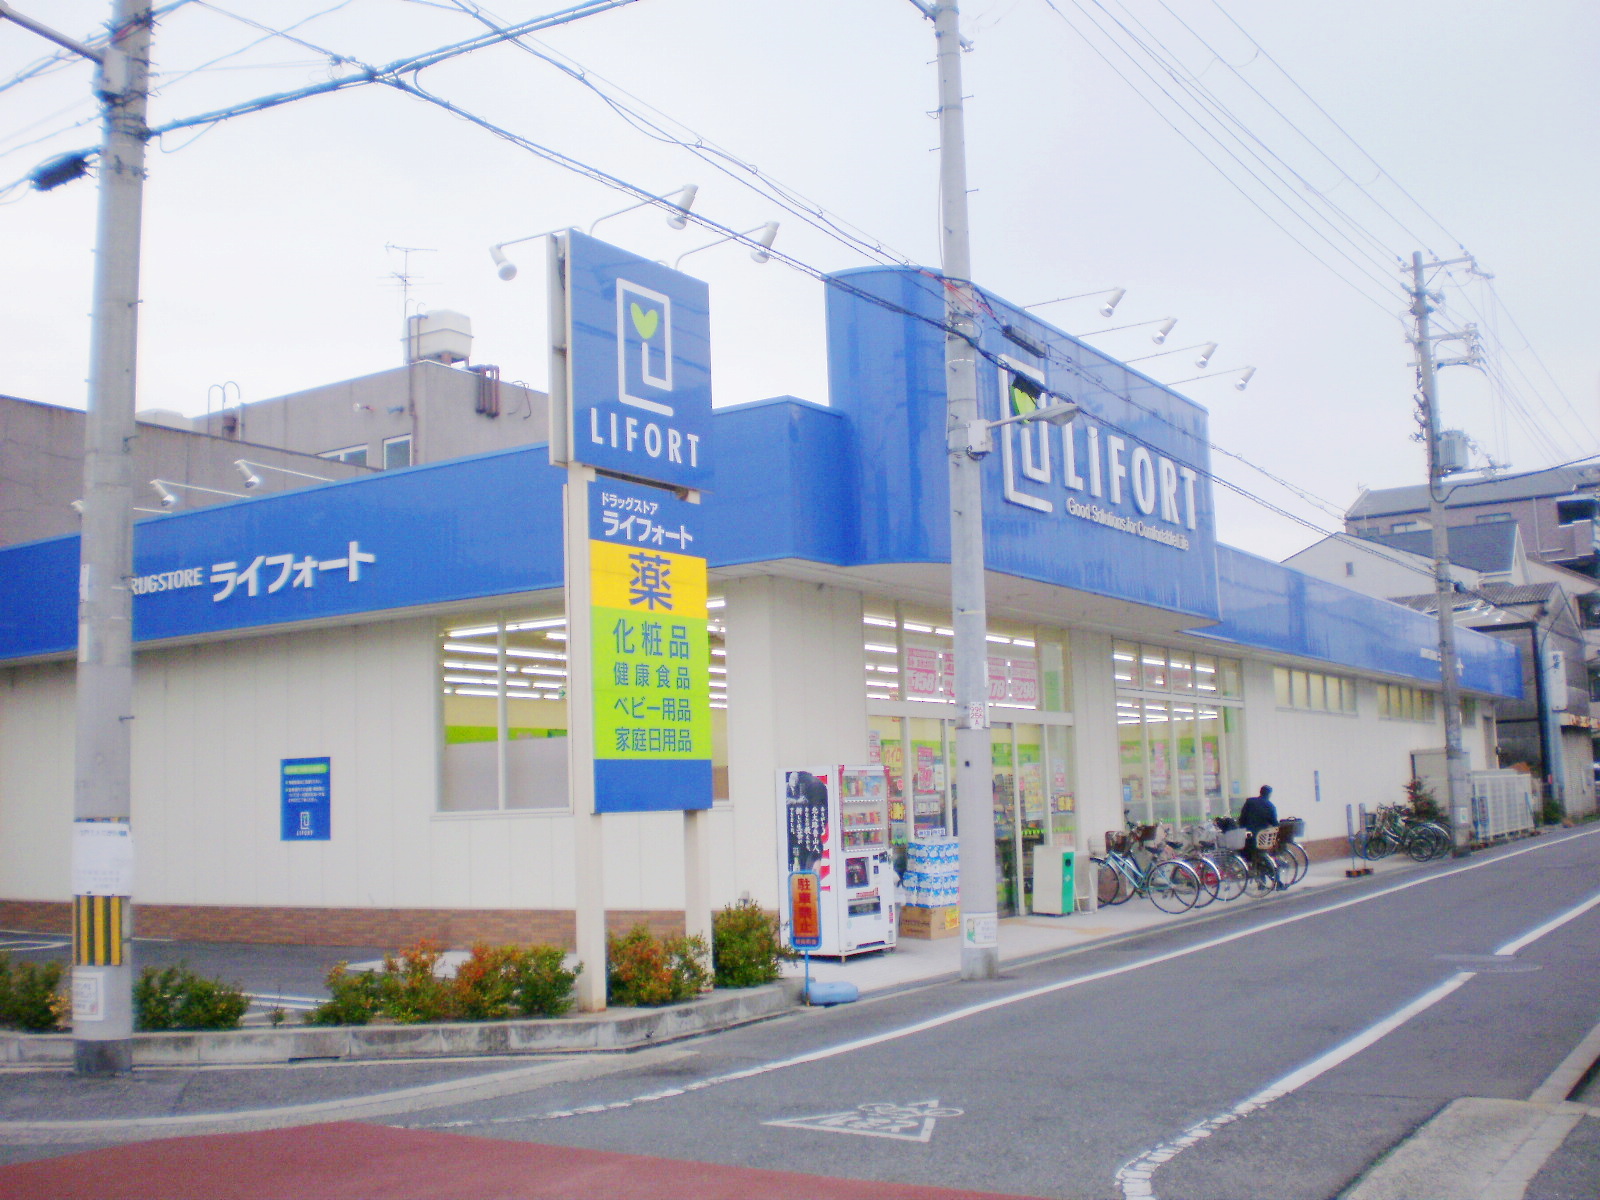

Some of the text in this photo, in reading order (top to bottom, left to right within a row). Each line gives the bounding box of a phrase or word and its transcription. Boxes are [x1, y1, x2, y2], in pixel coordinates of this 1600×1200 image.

[591, 407, 699, 467] LIFORT
[1062, 420, 1197, 530] LIFORT
[602, 492, 659, 515] ドラッグストア
[1066, 497, 1091, 520] Good
[1092, 505, 1126, 531] Solutions
[602, 510, 693, 550] ライフォート
[131, 541, 376, 602] RUGSTORE ライフォート
[628, 552, 673, 610] 薬
[612, 618, 690, 660] 化粧品
[613, 661, 690, 690] 健康食品
[613, 696, 691, 722] ベビー用品
[614, 726, 692, 752] 家庭日用品
